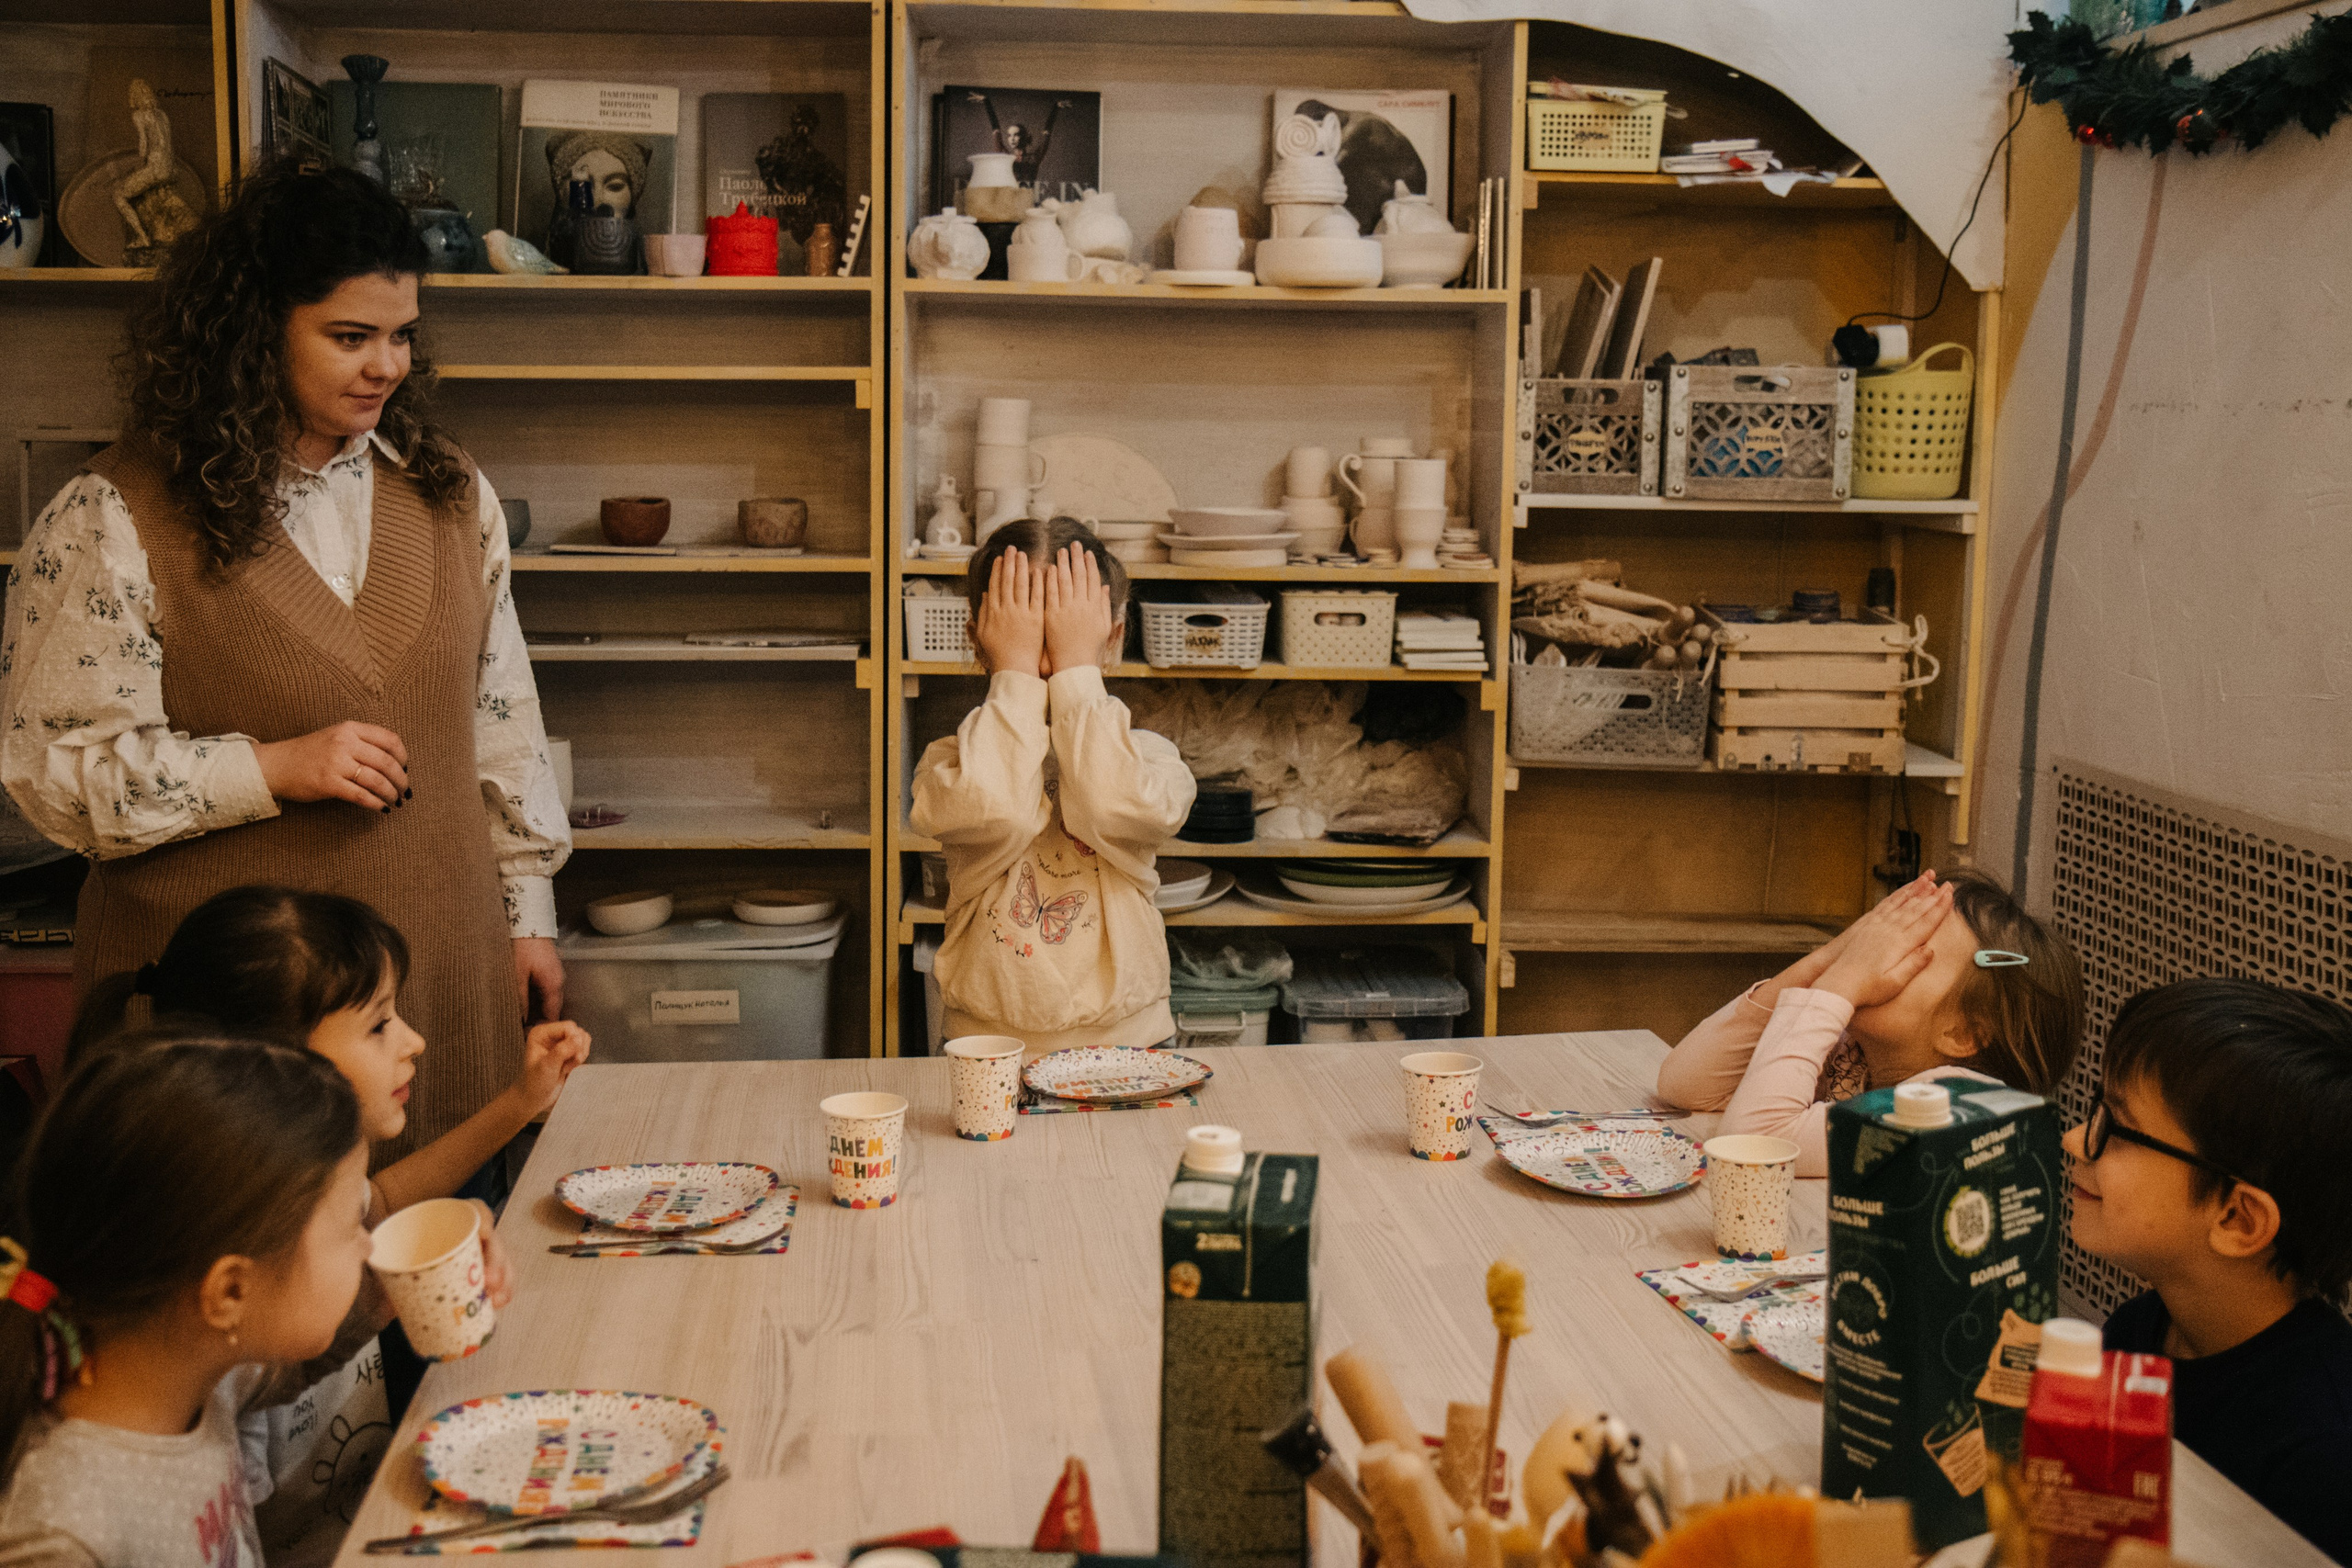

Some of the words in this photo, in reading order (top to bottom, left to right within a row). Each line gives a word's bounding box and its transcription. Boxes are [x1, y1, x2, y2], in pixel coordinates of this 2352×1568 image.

[599, 90, 659, 101] ПАМЯТНИКИ
[599, 100, 651, 109] МИРОВОГО
[599, 109, 652, 119] ИСКУССТВА
[830, 1134, 885, 1157] ДНЁМ
